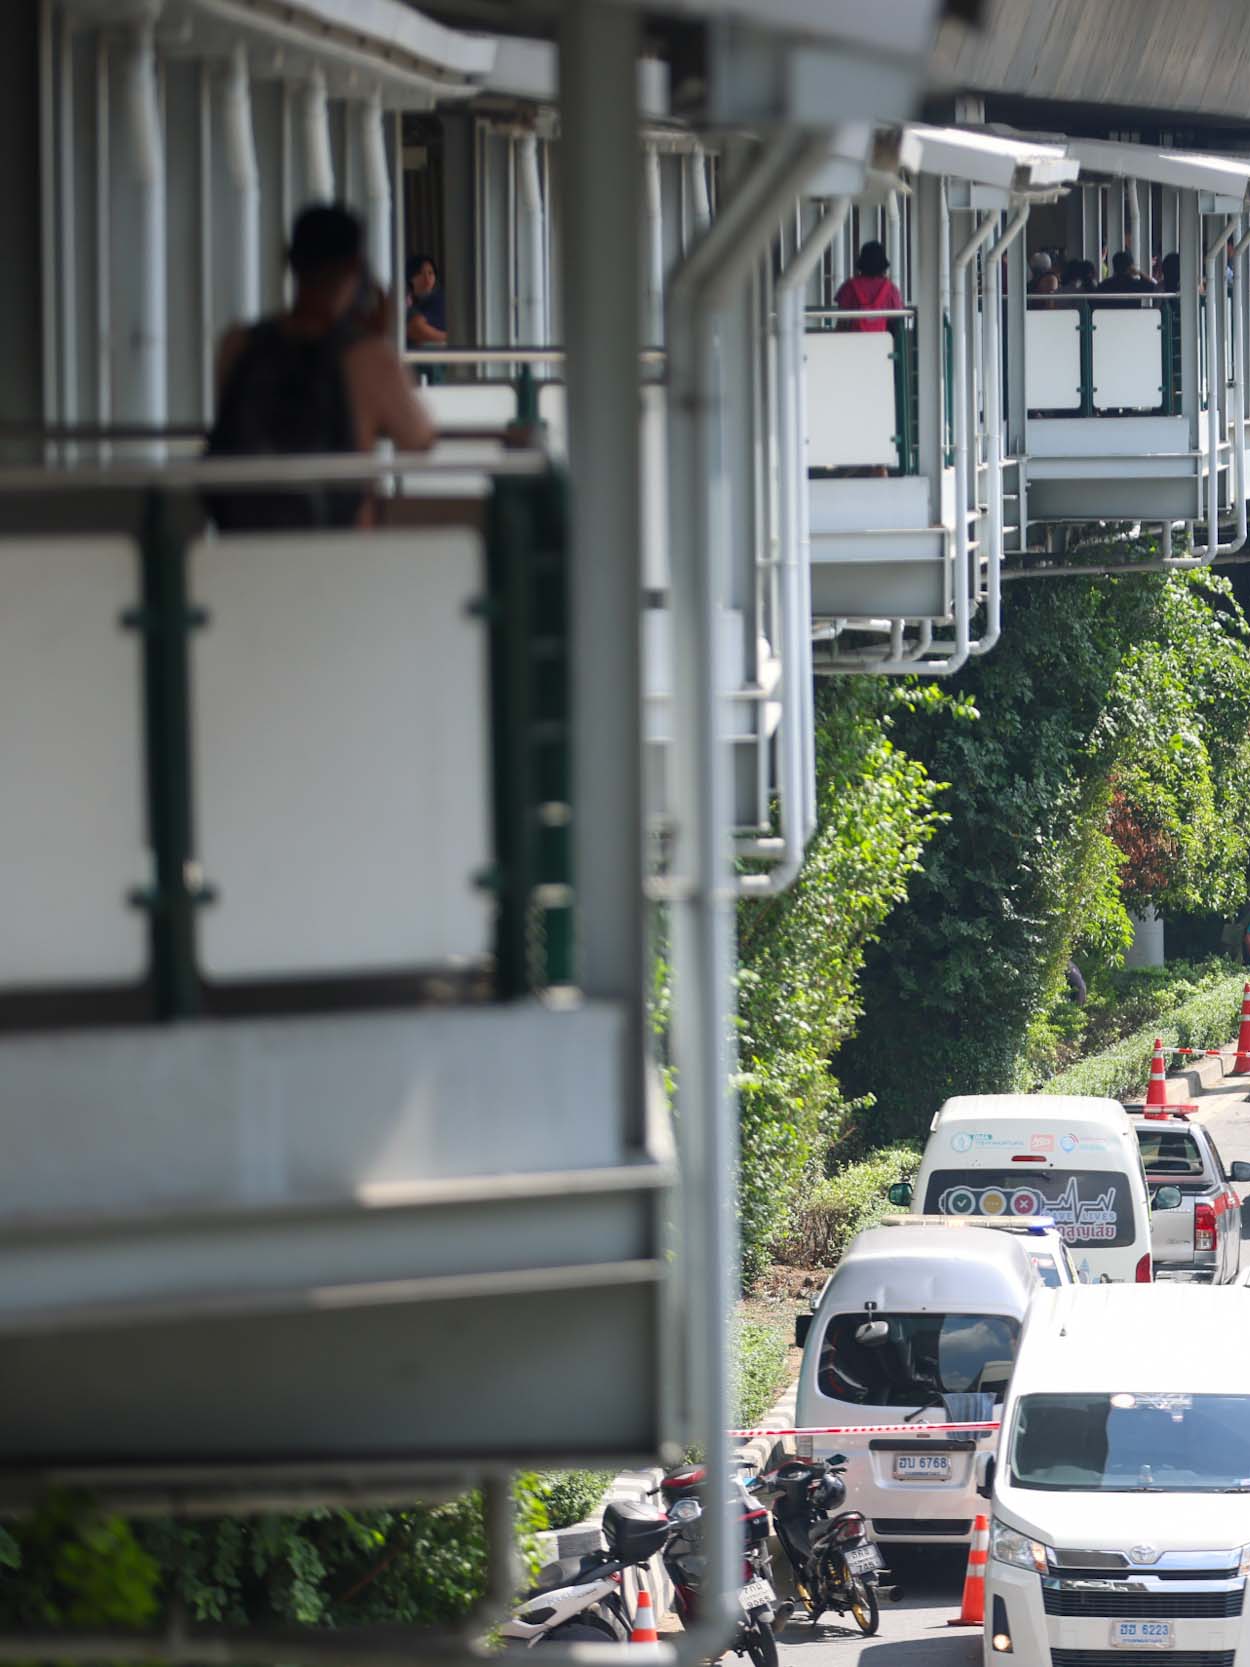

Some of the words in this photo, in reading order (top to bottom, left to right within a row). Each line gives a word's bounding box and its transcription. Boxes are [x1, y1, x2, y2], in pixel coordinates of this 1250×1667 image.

[1082, 1211, 1116, 1221] LIVES
[919, 1457, 946, 1468] 6768
[1142, 1624, 1168, 1635] 6223
